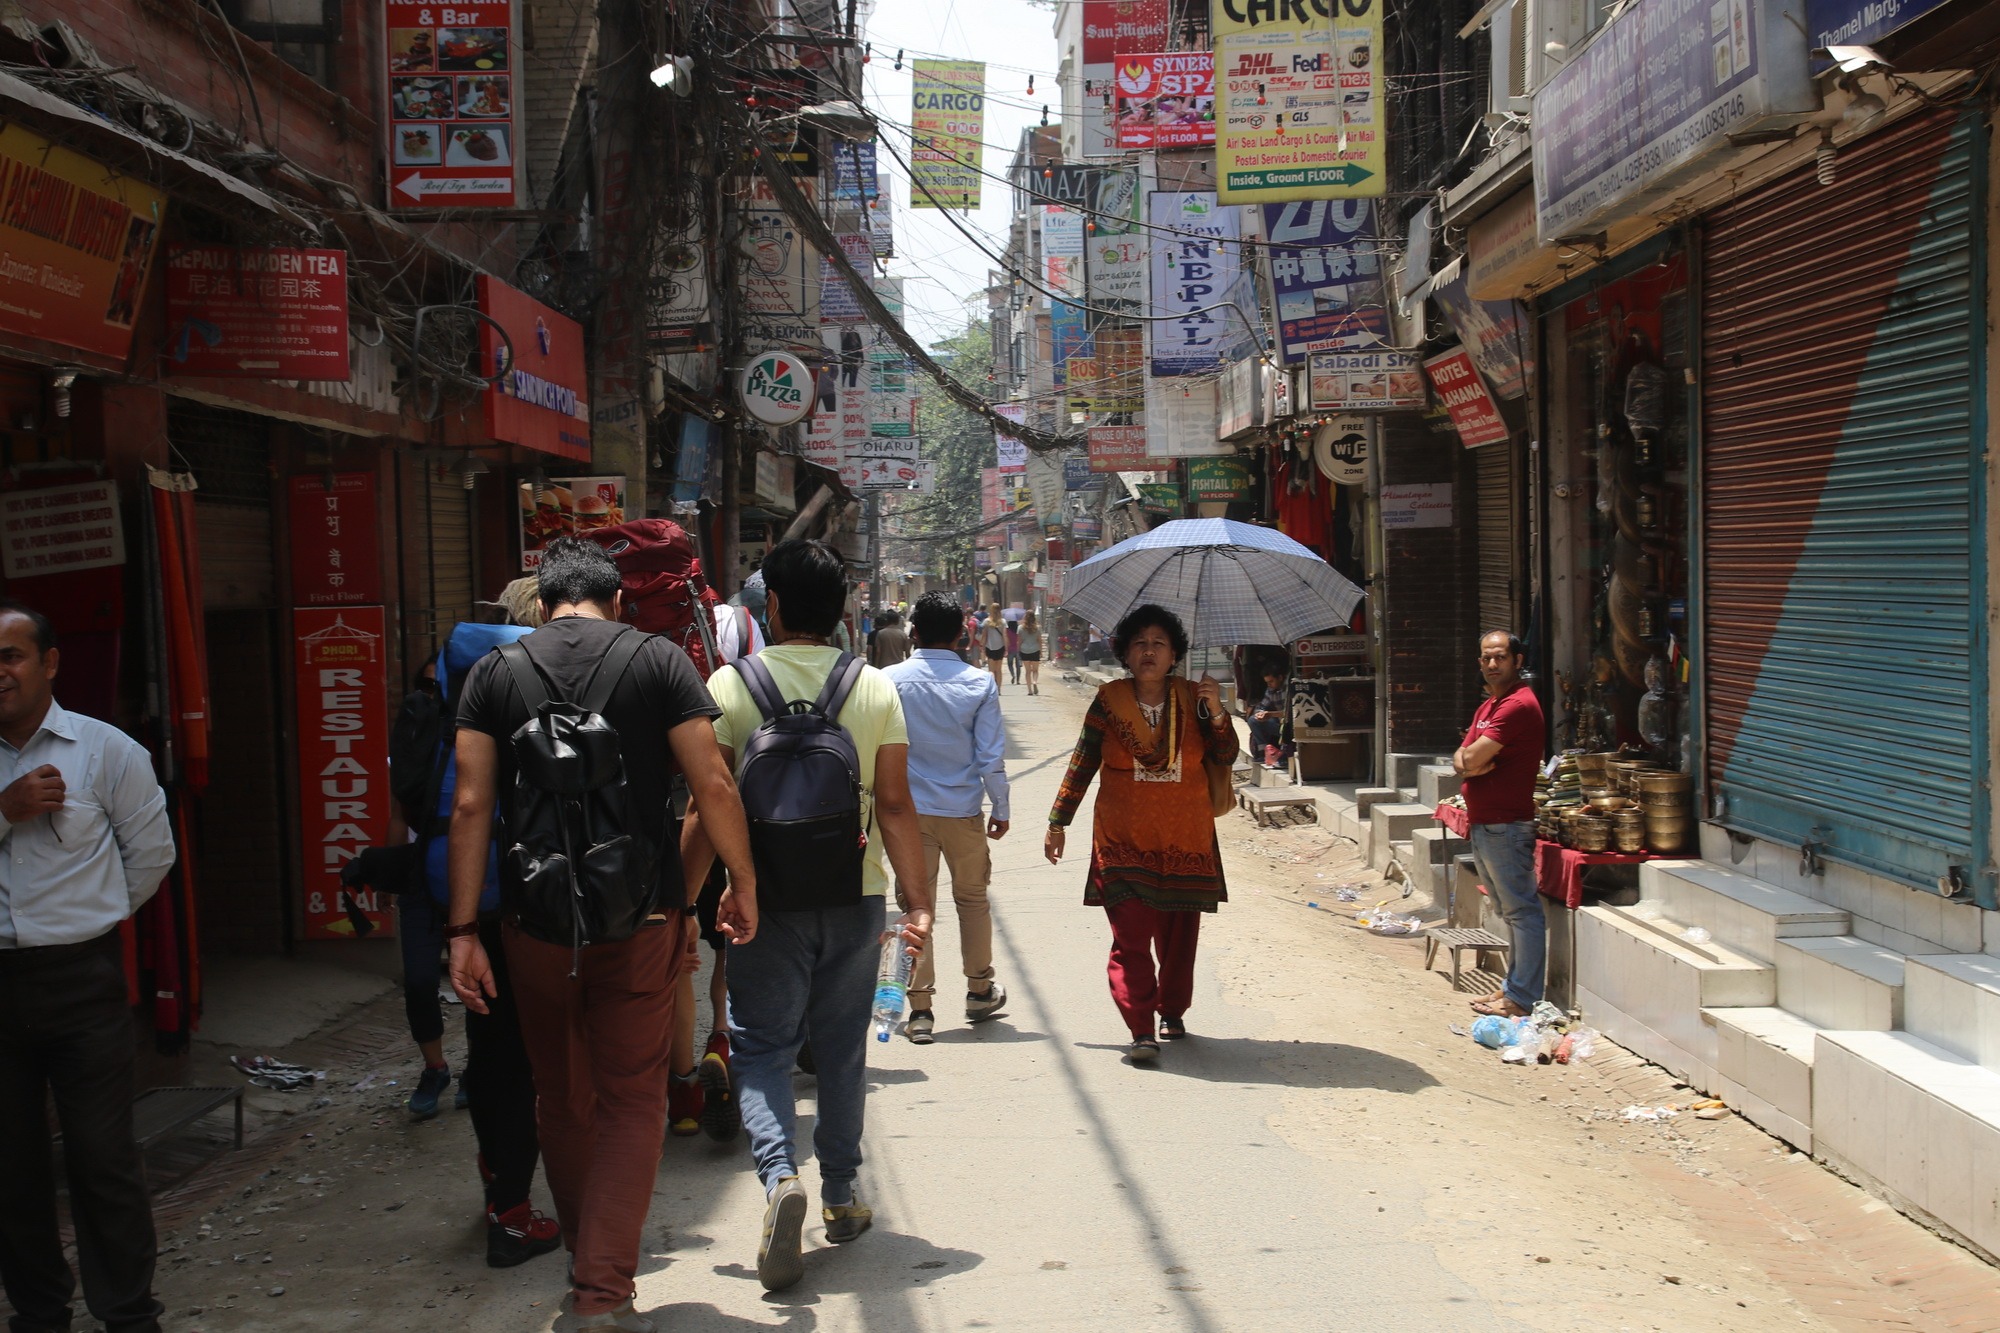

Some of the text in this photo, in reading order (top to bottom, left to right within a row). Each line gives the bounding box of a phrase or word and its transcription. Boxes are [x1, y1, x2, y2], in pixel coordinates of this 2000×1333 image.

[419, 9, 480, 25] & Bar
[1222, 0, 1373, 27] CARGO
[1085, 21, 1166, 40] San Miguel
[1818, 13, 1862, 50] Thamel
[1589, 44, 1605, 90] Art
[1607, 20, 1629, 74] and
[1647, 40, 1680, 80] Singing
[1680, 19, 1705, 57] Bowls
[1237, 53, 1278, 76] DHL
[1292, 53, 1342, 73] FedEx
[1348, 53, 1370, 67] ups
[913, 92, 984, 112] CARGO
[1292, 111, 1309, 122] GLS
[946, 121, 981, 136] TNT
[1170, 133, 1198, 143] FLOOR
[1259, 130, 1374, 148] Land Cargo & Courie Air Mail
[1235, 153, 1259, 167] Postal
[1261, 151, 1290, 165] Service
[1292, 151, 1298, 163] &
[1300, 149, 1337, 163] Domestic
[1229, 169, 1345, 187] Inside, Ground FLOOR
[1542, 204, 1566, 232] Thamel
[1169, 223, 1225, 238] View
[839, 235, 870, 246] NEPAL
[307, 256, 340, 276] TEA
[748, 279, 788, 287] ATLAS
[747, 291, 790, 299] CARGO
[1178, 240, 1214, 346] NEPAL
[775, 325, 816, 339] EXPORT
[1306, 337, 1346, 351] Inside
[1313, 354, 1380, 370] Sabadi
[1431, 360, 1470, 386] HOTEL
[514, 369, 558, 411] SANDWICH
[746, 376, 802, 404] Pizza
[777, 401, 801, 411] Cutter
[843, 414, 866, 425] 00%
[1092, 429, 1124, 441] HOUSE OF
[805, 440, 837, 451] 100%
[1092, 445, 1101, 455] La
[1101, 444, 1123, 455] Maison
[1333, 441, 1367, 457] WiF
[1217, 459, 1249, 474] Come
[1344, 468, 1364, 476] ZONE
[1191, 478, 1249, 491] FISHTAIL SPA
[1166, 498, 1179, 508] SPA
[25, 515, 43, 529] PURE
[30, 534, 49, 548] PURE
[310, 592, 365, 603] First Floor
[1312, 640, 1365, 652] ENTERPRISES
[319, 668, 374, 888] RESTAURAN
[308, 892, 328, 914] &
